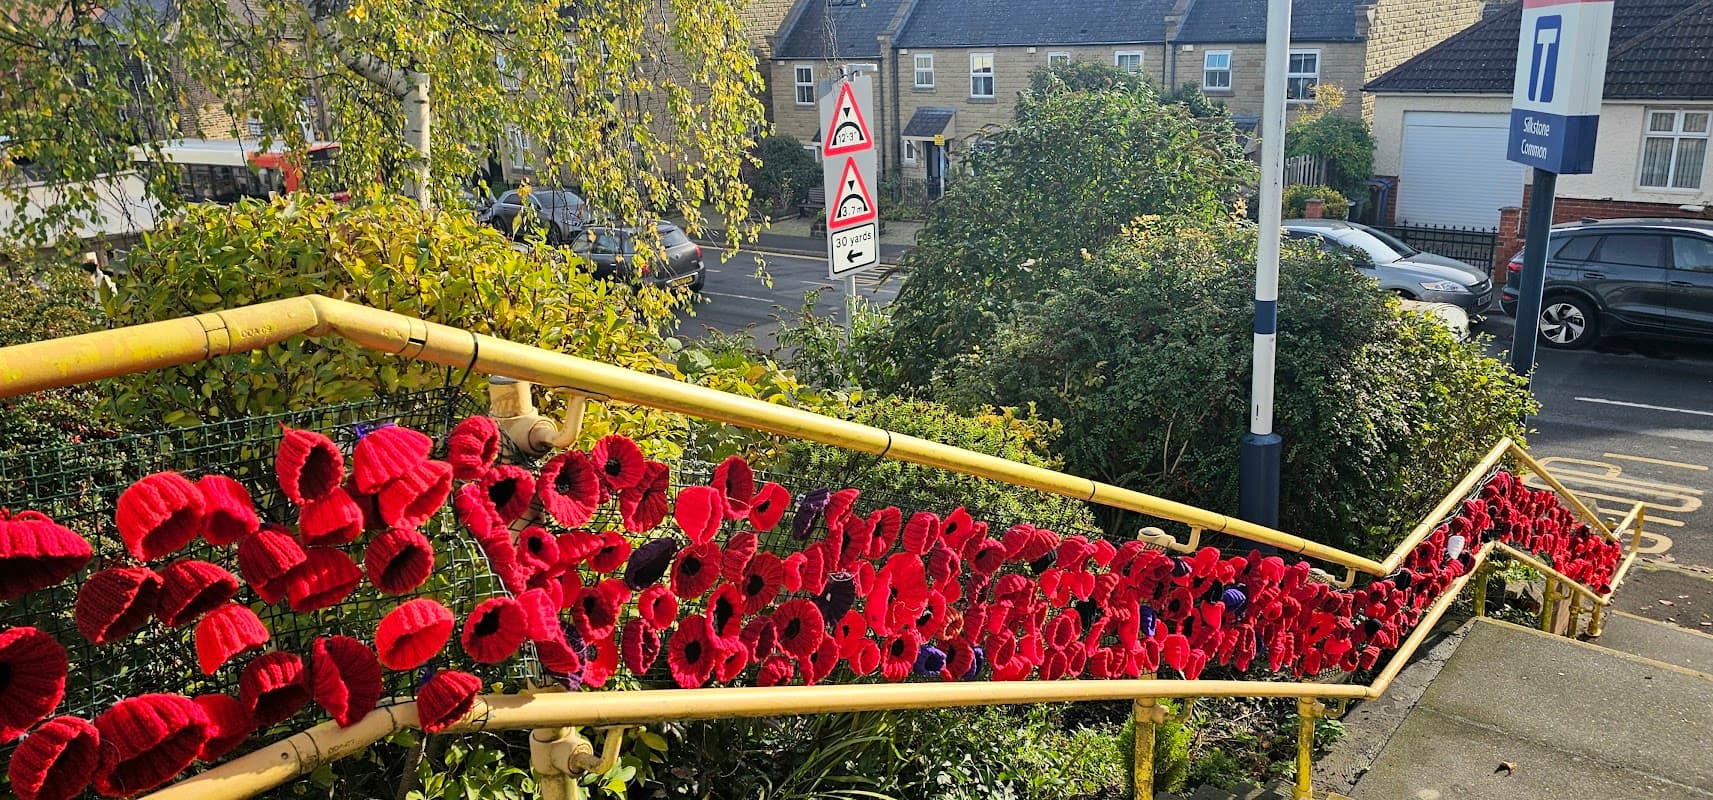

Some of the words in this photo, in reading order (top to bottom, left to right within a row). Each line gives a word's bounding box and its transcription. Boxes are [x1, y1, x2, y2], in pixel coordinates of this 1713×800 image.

[1523, 117, 1550, 137] Silkstone
[1521, 139, 1548, 160] Common
[836, 236, 848, 248] 30
[850, 232, 872, 246] yards
